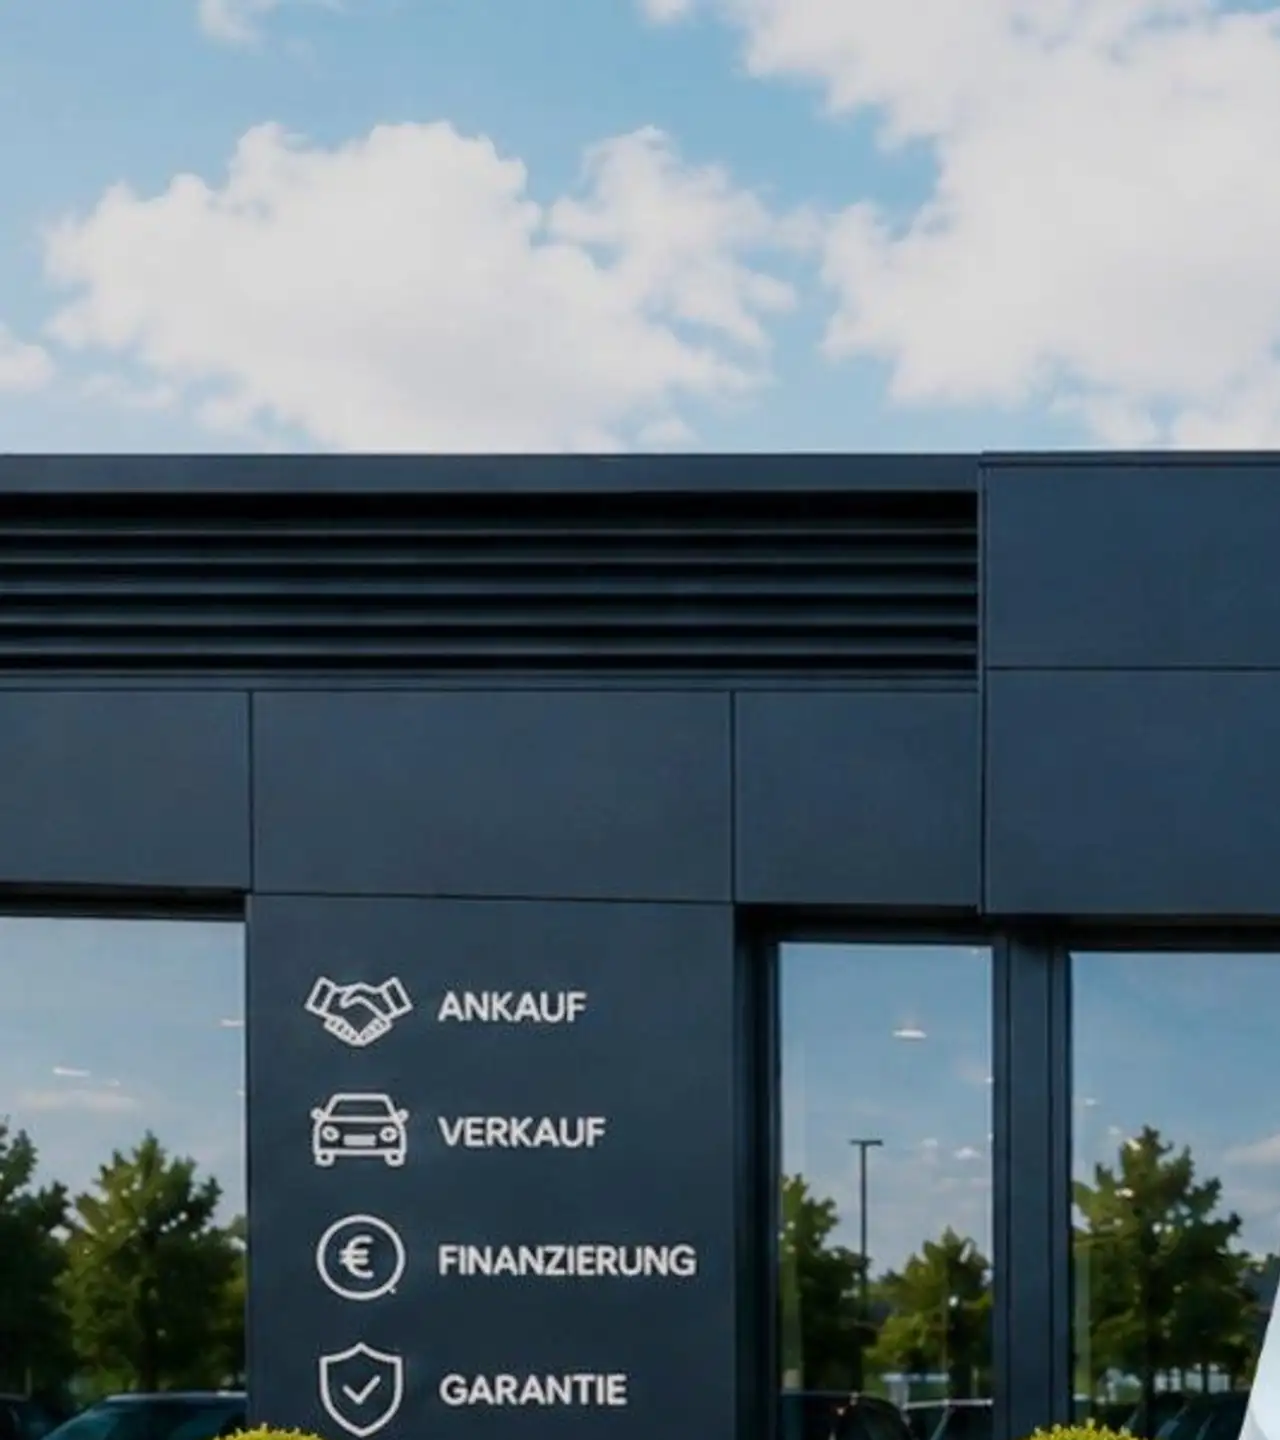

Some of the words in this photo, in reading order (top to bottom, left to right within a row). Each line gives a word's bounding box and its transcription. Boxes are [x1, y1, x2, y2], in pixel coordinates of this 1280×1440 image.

[438, 991, 587, 1022] ANKAUF
[438, 1117, 606, 1148] VERKAUF
[438, 1245, 697, 1276] FINANZIERUNG
[439, 1373, 628, 1406] GARANTIE
